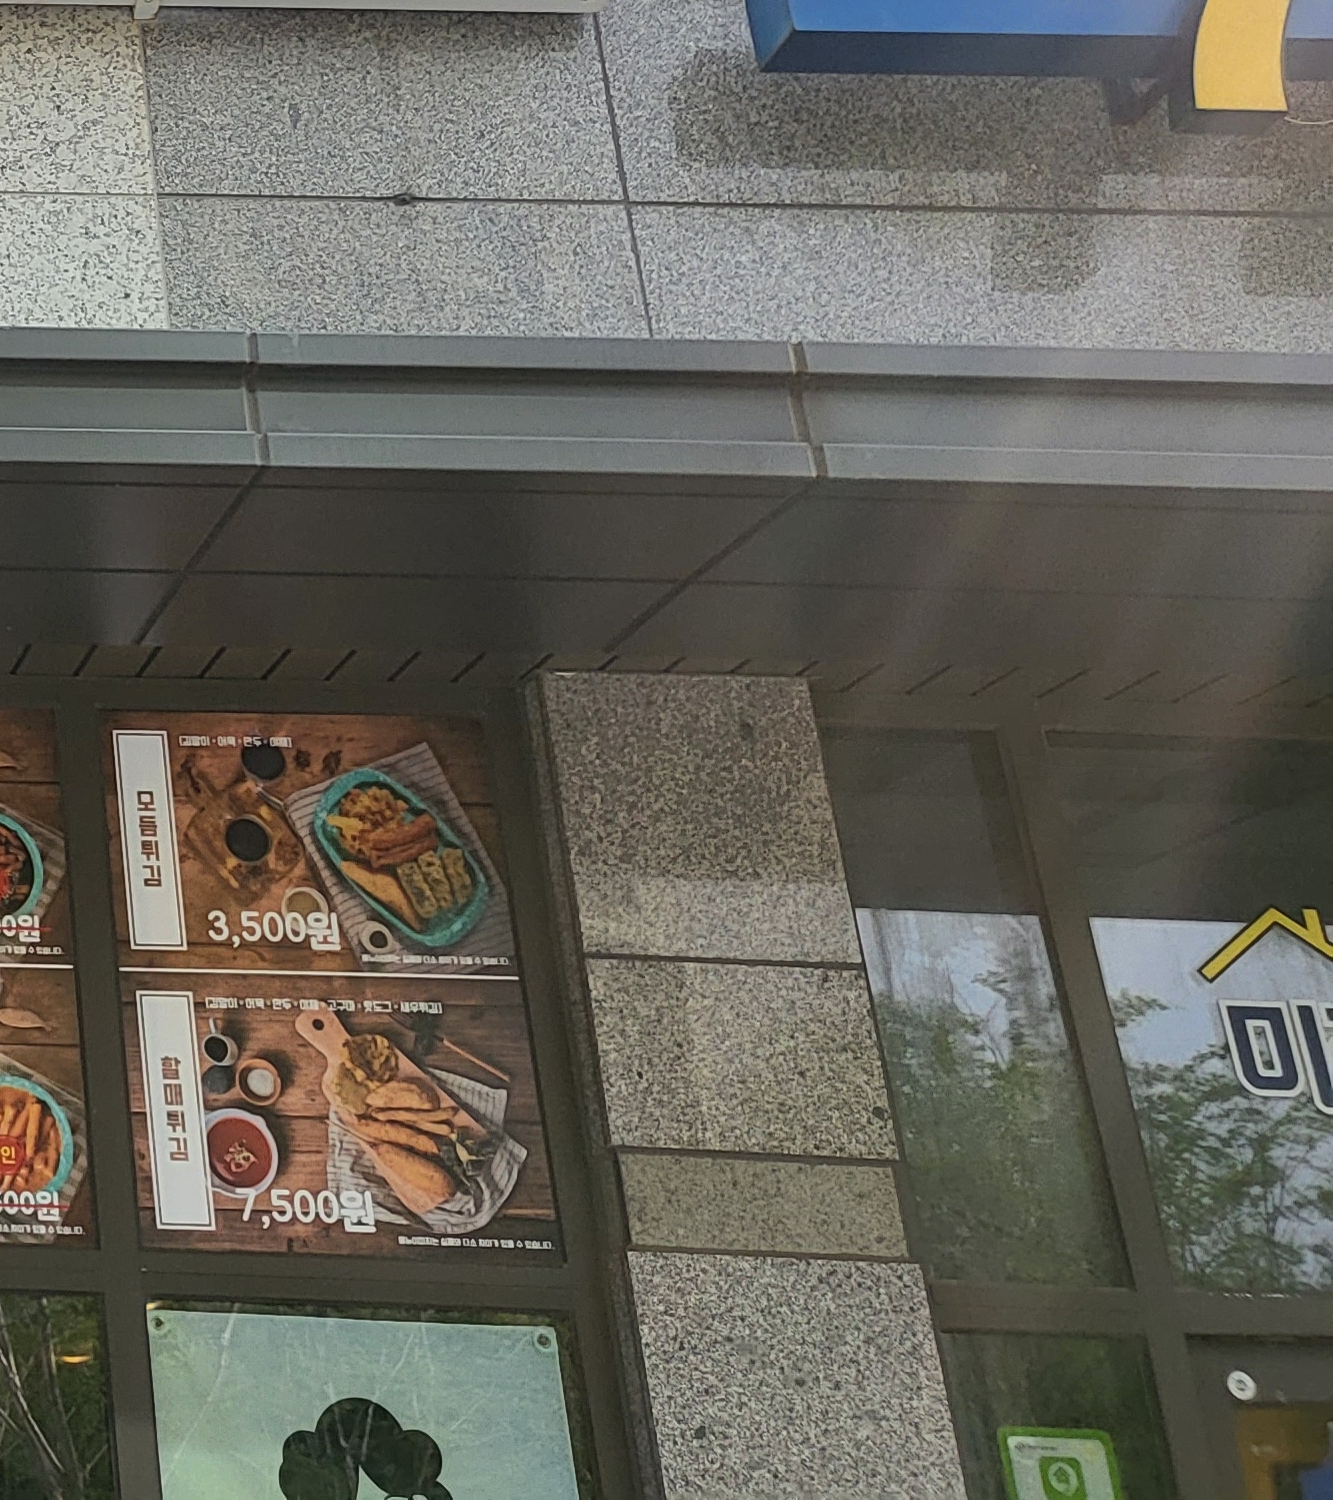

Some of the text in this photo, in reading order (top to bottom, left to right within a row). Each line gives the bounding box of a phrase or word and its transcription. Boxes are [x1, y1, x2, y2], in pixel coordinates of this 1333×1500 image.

[207, 910, 341, 952] 3,500원
[160, 1055, 190, 1163] 할매튀김
[239, 1188, 378, 1234] 7,500원
